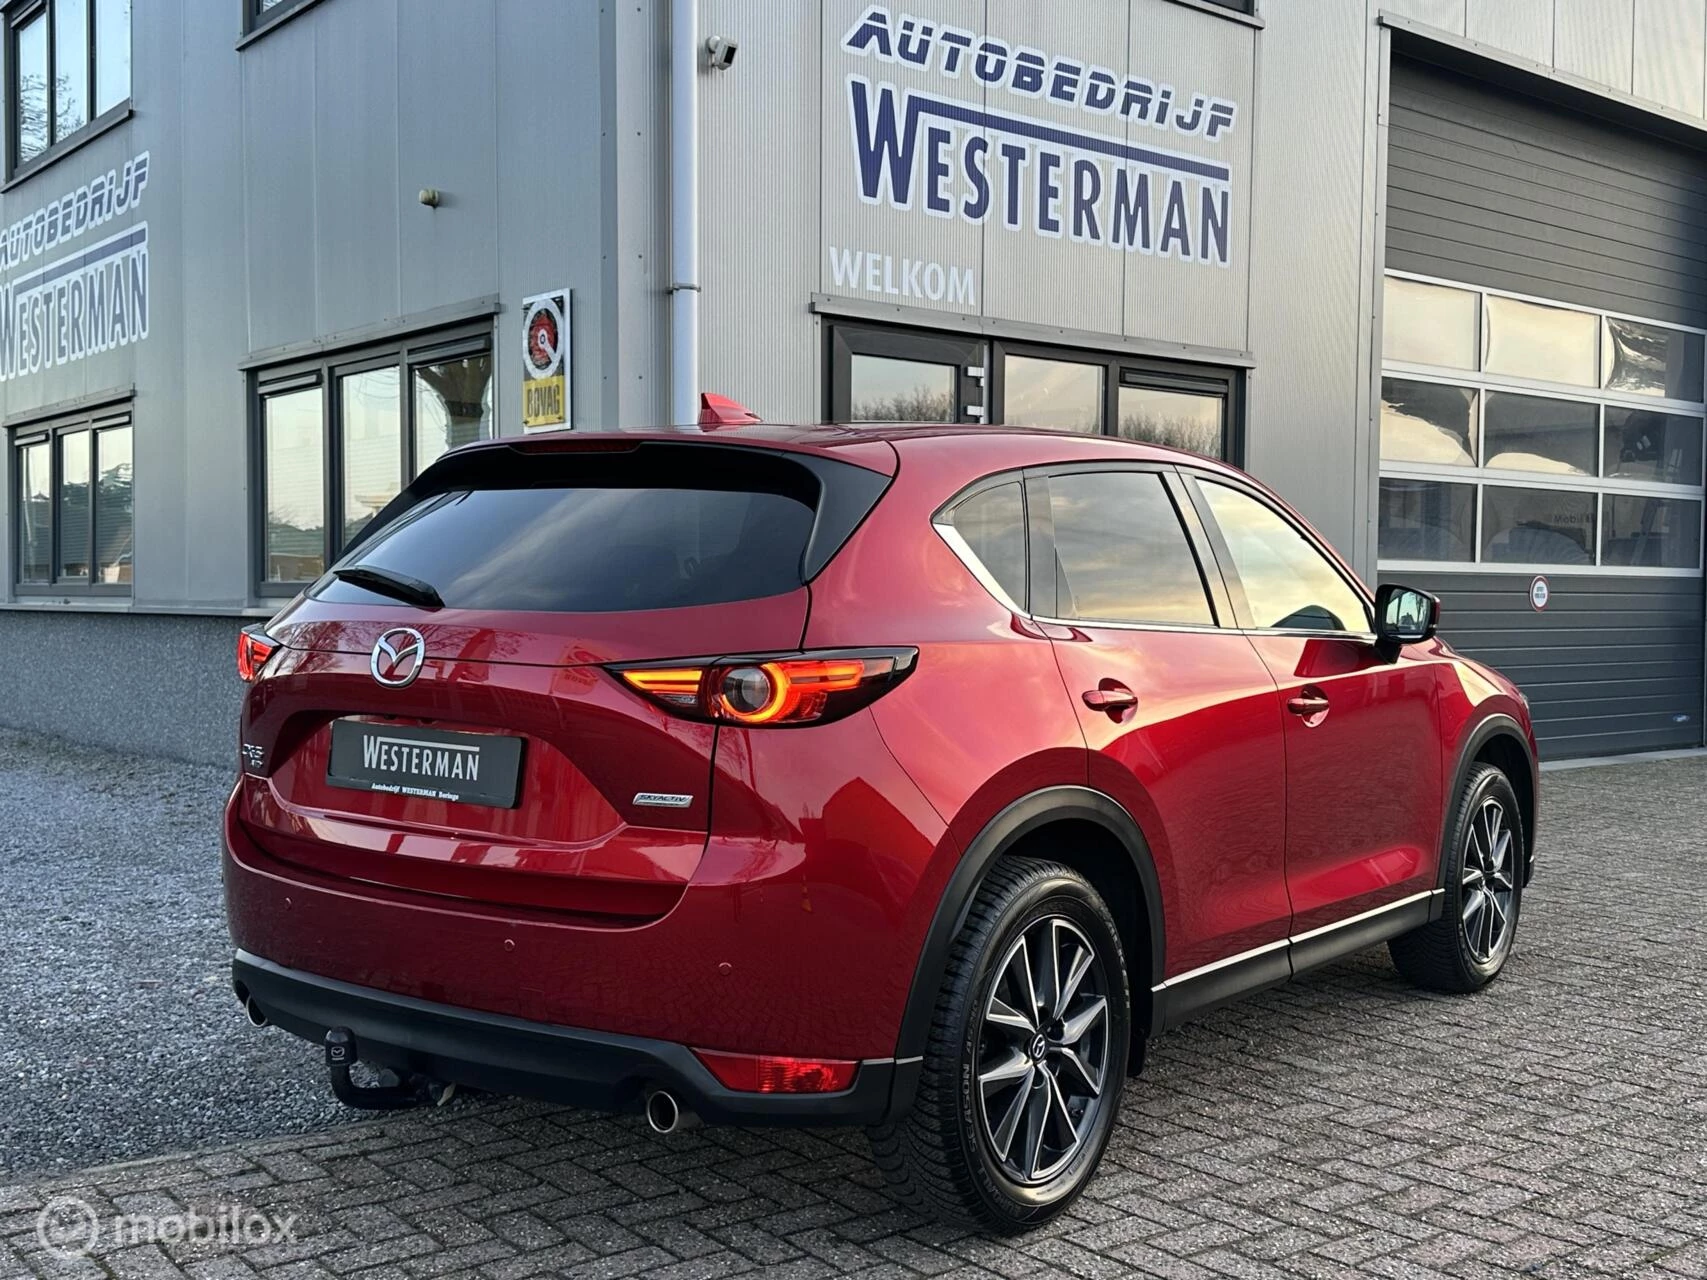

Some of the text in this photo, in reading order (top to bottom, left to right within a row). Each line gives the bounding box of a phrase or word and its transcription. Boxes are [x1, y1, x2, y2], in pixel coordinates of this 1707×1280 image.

[846, 10, 1235, 138] AUTOBEDRIJF
[851, 79, 1230, 263] WESTERMAN
[829, 246, 976, 306] WELKOM
[527, 385, 560, 417] BOVAG
[363, 734, 480, 781] WESTERMAN
[402, 786, 436, 797] WESTERMAN
[639, 794, 687, 803] SKYACTIV
[962, 1063, 978, 1153] SEASON
